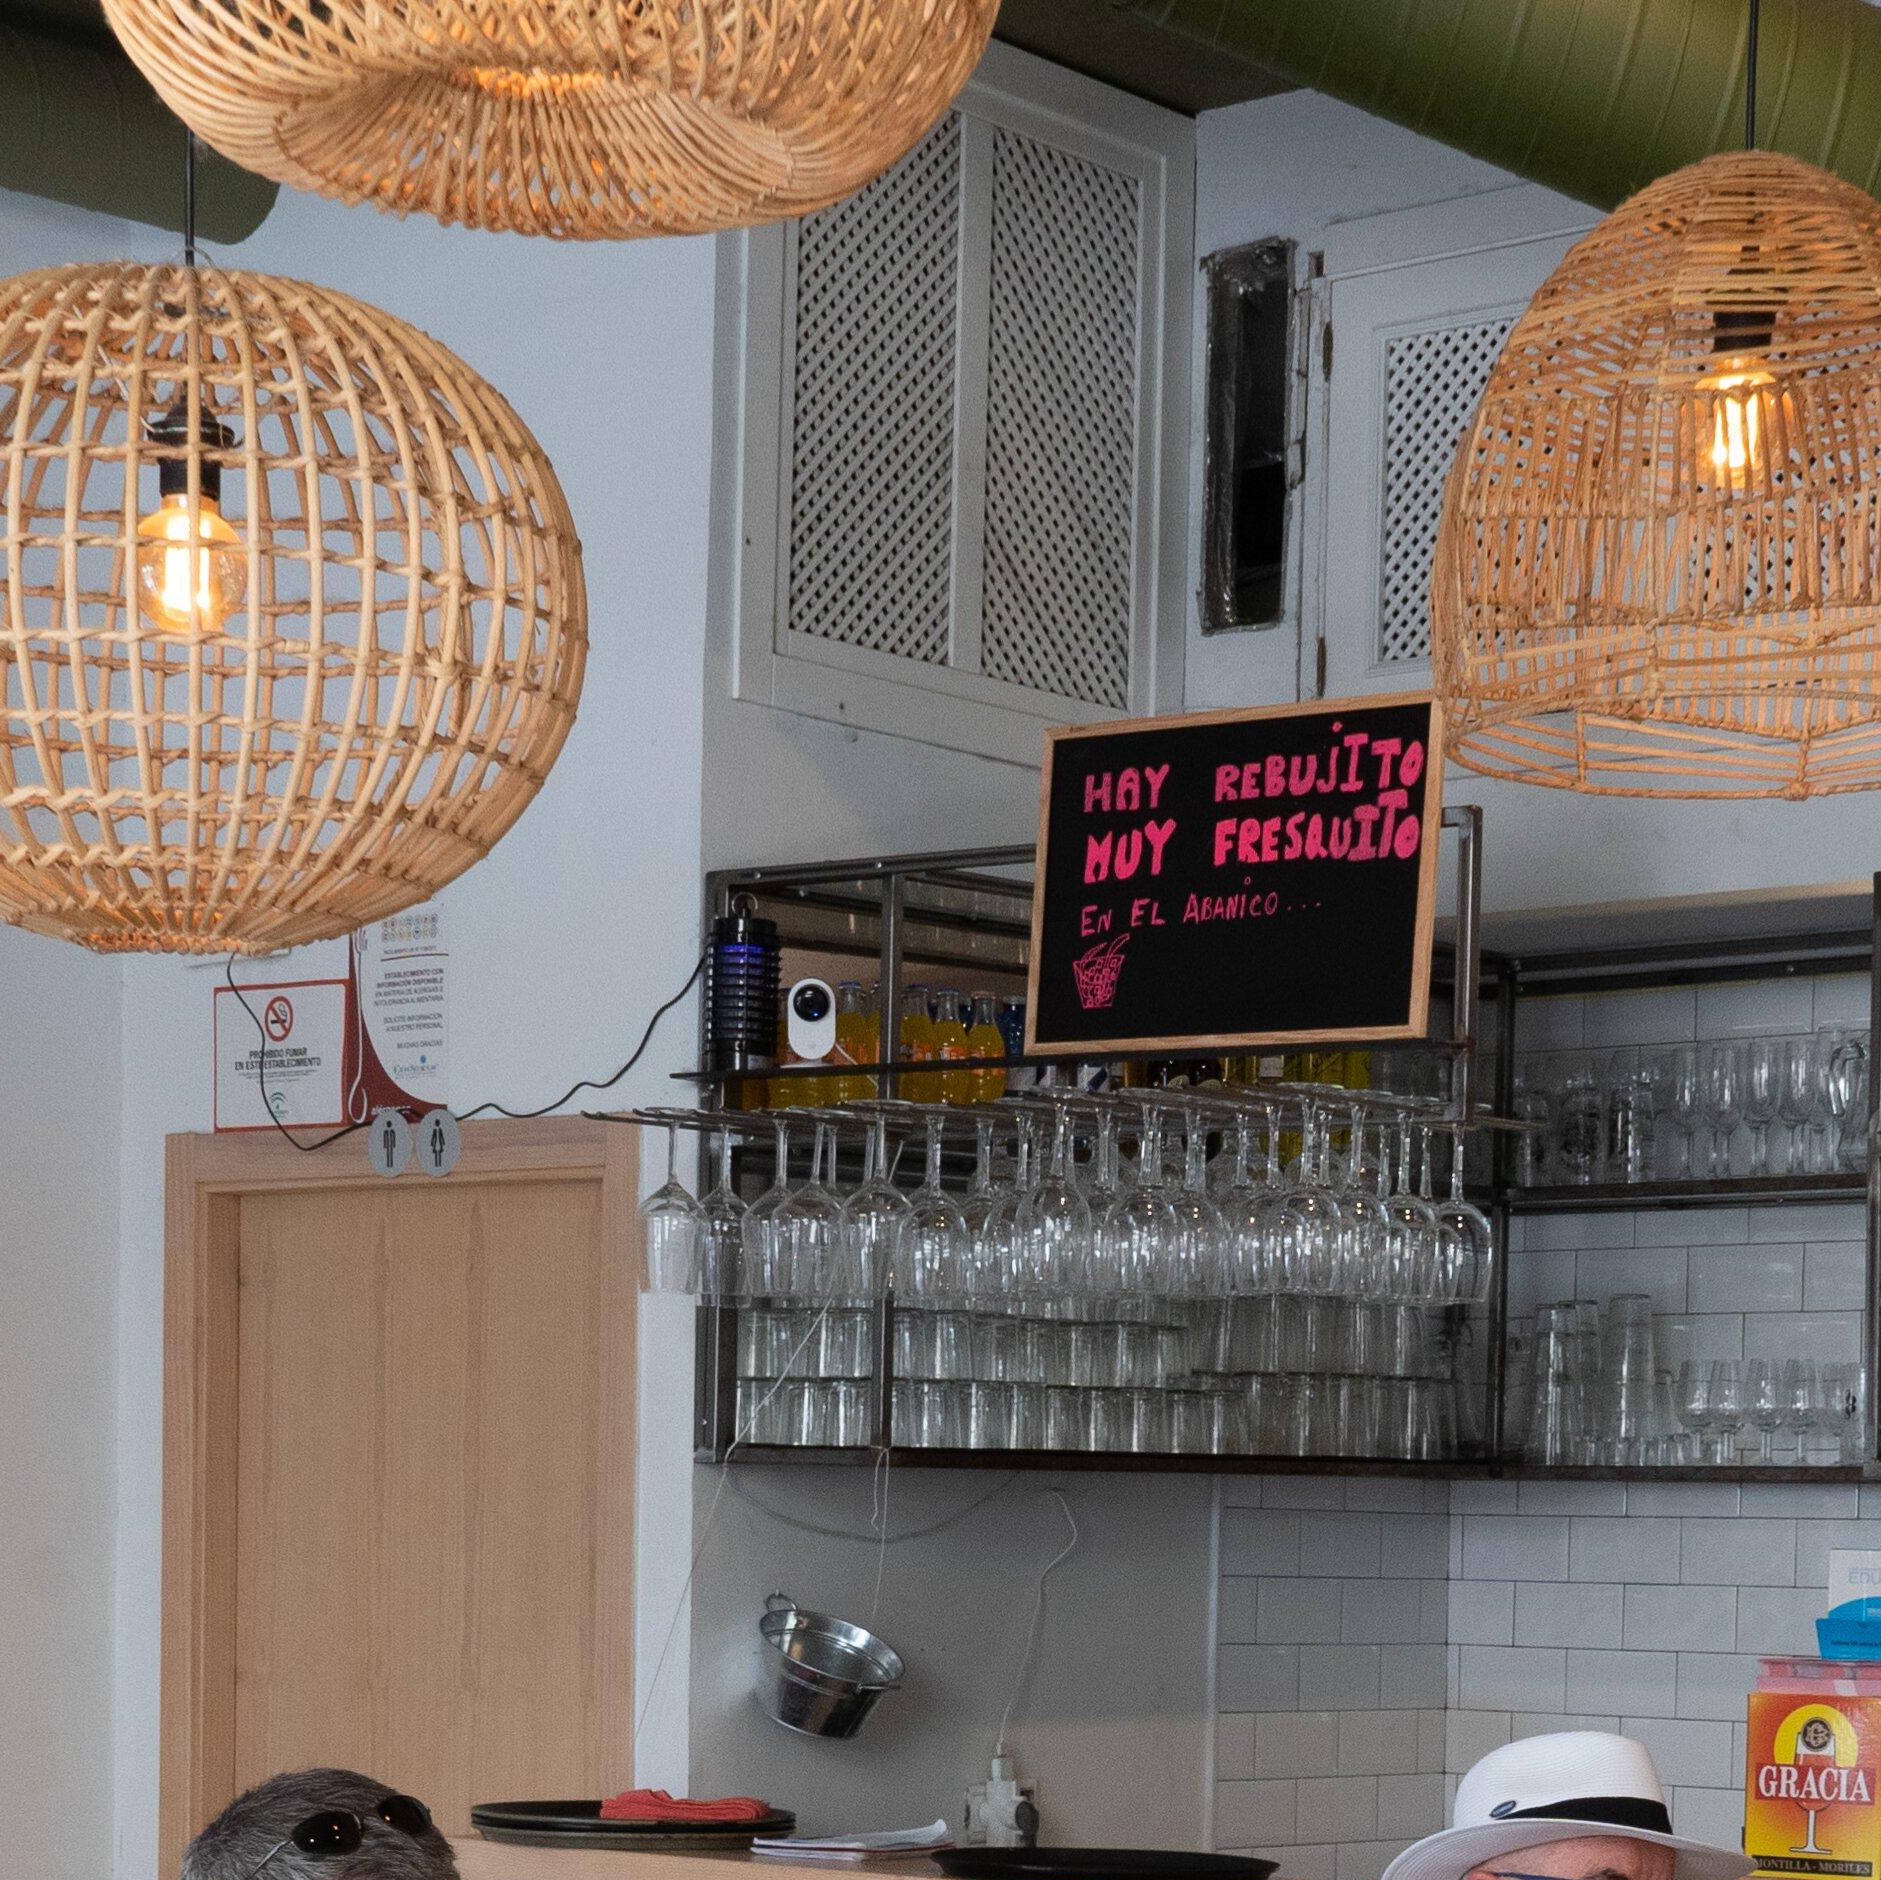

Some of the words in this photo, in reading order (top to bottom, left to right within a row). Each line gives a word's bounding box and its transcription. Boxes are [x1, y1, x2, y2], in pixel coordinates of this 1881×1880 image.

[1083, 764, 1170, 813] HAY
[1214, 721, 1425, 802] REBUJITO
[1083, 818, 1177, 885] MUY
[1213, 790, 1420, 866] FRESQUITO
[1130, 898, 1166, 928] EL
[1758, 1765, 1871, 1802] GRACIA
[1819, 1862, 1870, 1874] MORILES
